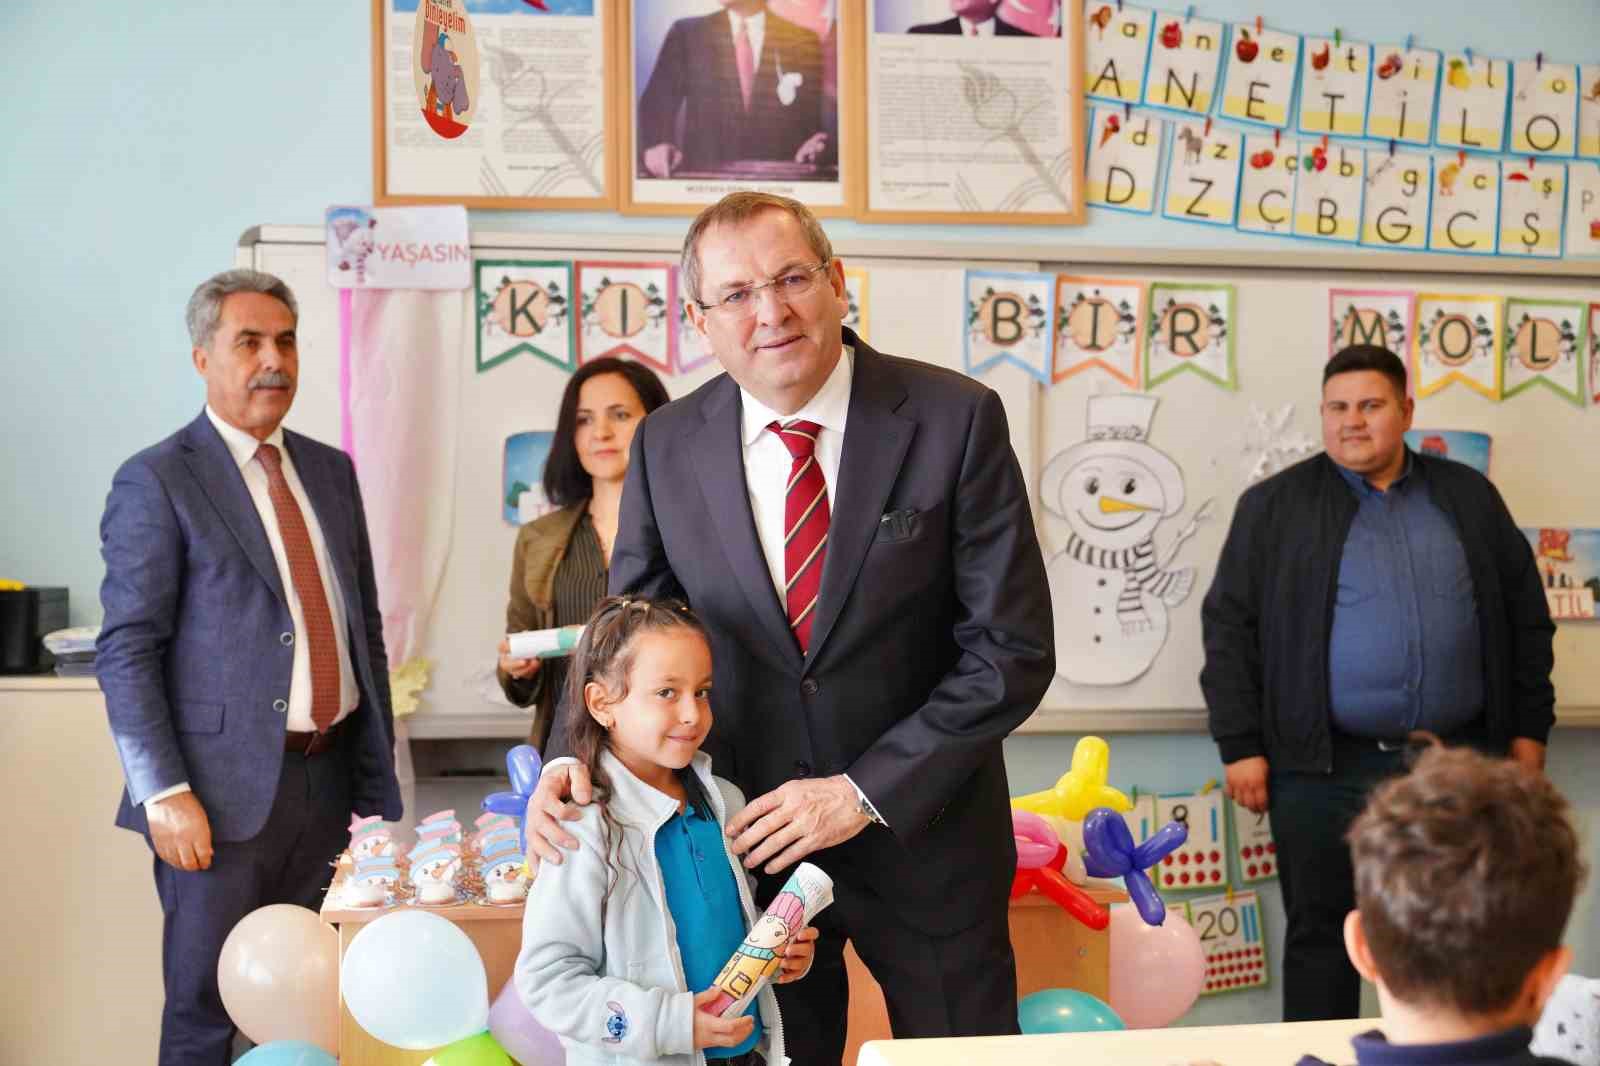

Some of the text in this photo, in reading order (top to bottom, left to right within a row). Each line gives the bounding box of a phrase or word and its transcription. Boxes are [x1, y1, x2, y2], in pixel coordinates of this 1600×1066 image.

[1121, 22, 1137, 37] a
[1196, 35, 1211, 50] n
[1271, 47, 1284, 61] e
[1346, 48, 1356, 72] t
[1413, 58, 1422, 79] i
[1091, 59, 1121, 97] A
[1164, 68, 1198, 108] N
[1246, 81, 1270, 121] E
[1322, 93, 1345, 131] T
[1461, 108, 1481, 146] L
[1526, 115, 1560, 151] O
[1132, 120, 1149, 146] d
[1213, 143, 1228, 160] z
[1339, 149, 1354, 177] b
[1401, 169, 1418, 197] g
[1473, 174, 1488, 189] c
[1105, 166, 1135, 204] D
[1186, 177, 1213, 217] Z
[1317, 198, 1337, 235] B
[1376, 206, 1412, 243] G
[1447, 212, 1478, 249] C
[377, 242, 466, 268] YAŞASIN
[1197, 906, 1239, 940] 20
